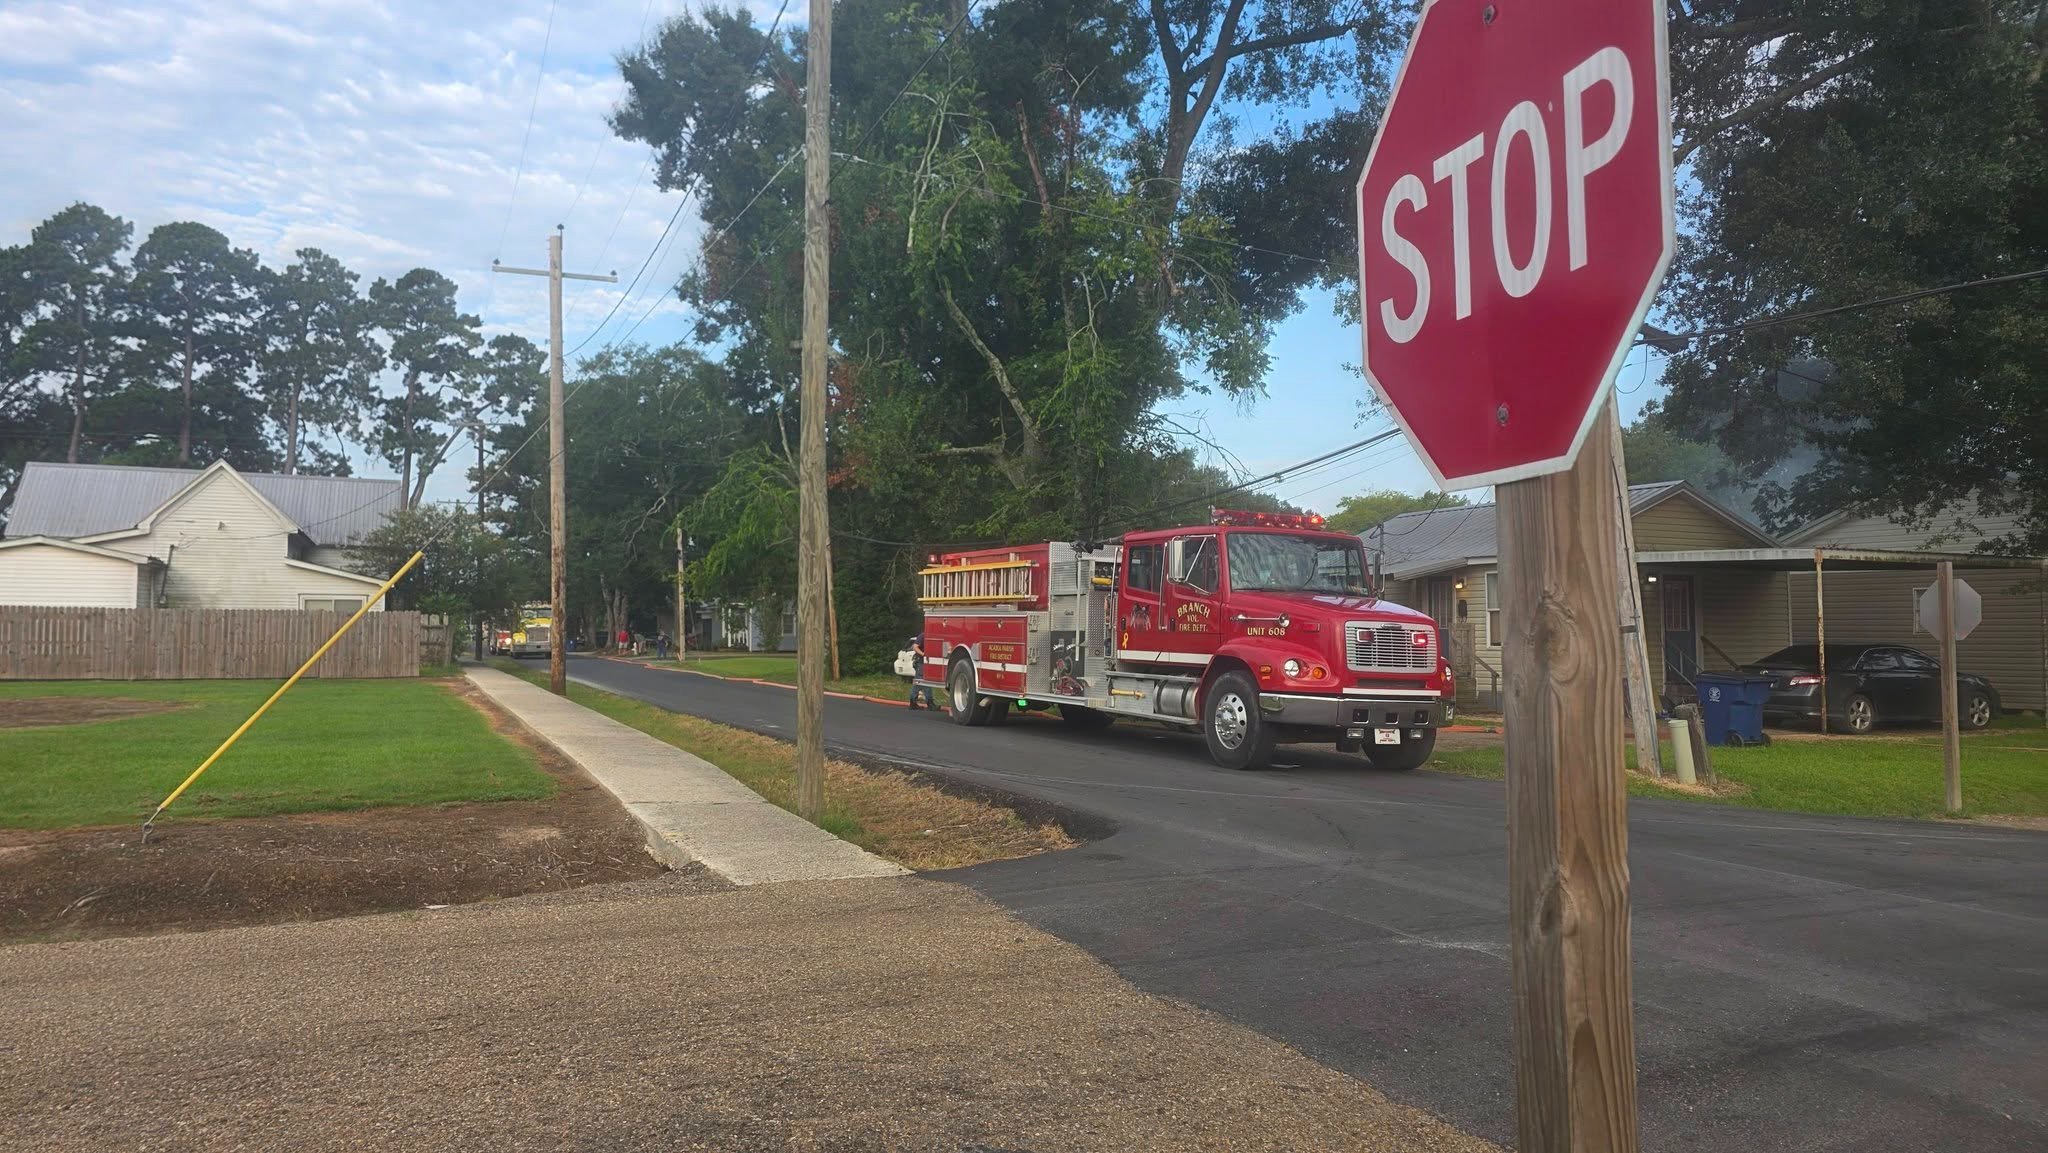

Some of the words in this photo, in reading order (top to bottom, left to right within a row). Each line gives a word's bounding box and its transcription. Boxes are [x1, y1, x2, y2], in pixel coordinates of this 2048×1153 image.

[1380, 46, 1634, 344] STOP
[1177, 602, 1210, 618] BRANCH
[1179, 623, 1190, 632] FIRE
[1192, 623, 1208, 632] DEPT.
[1247, 627, 1265, 636] UNIT
[1268, 627, 1285, 636] 608
